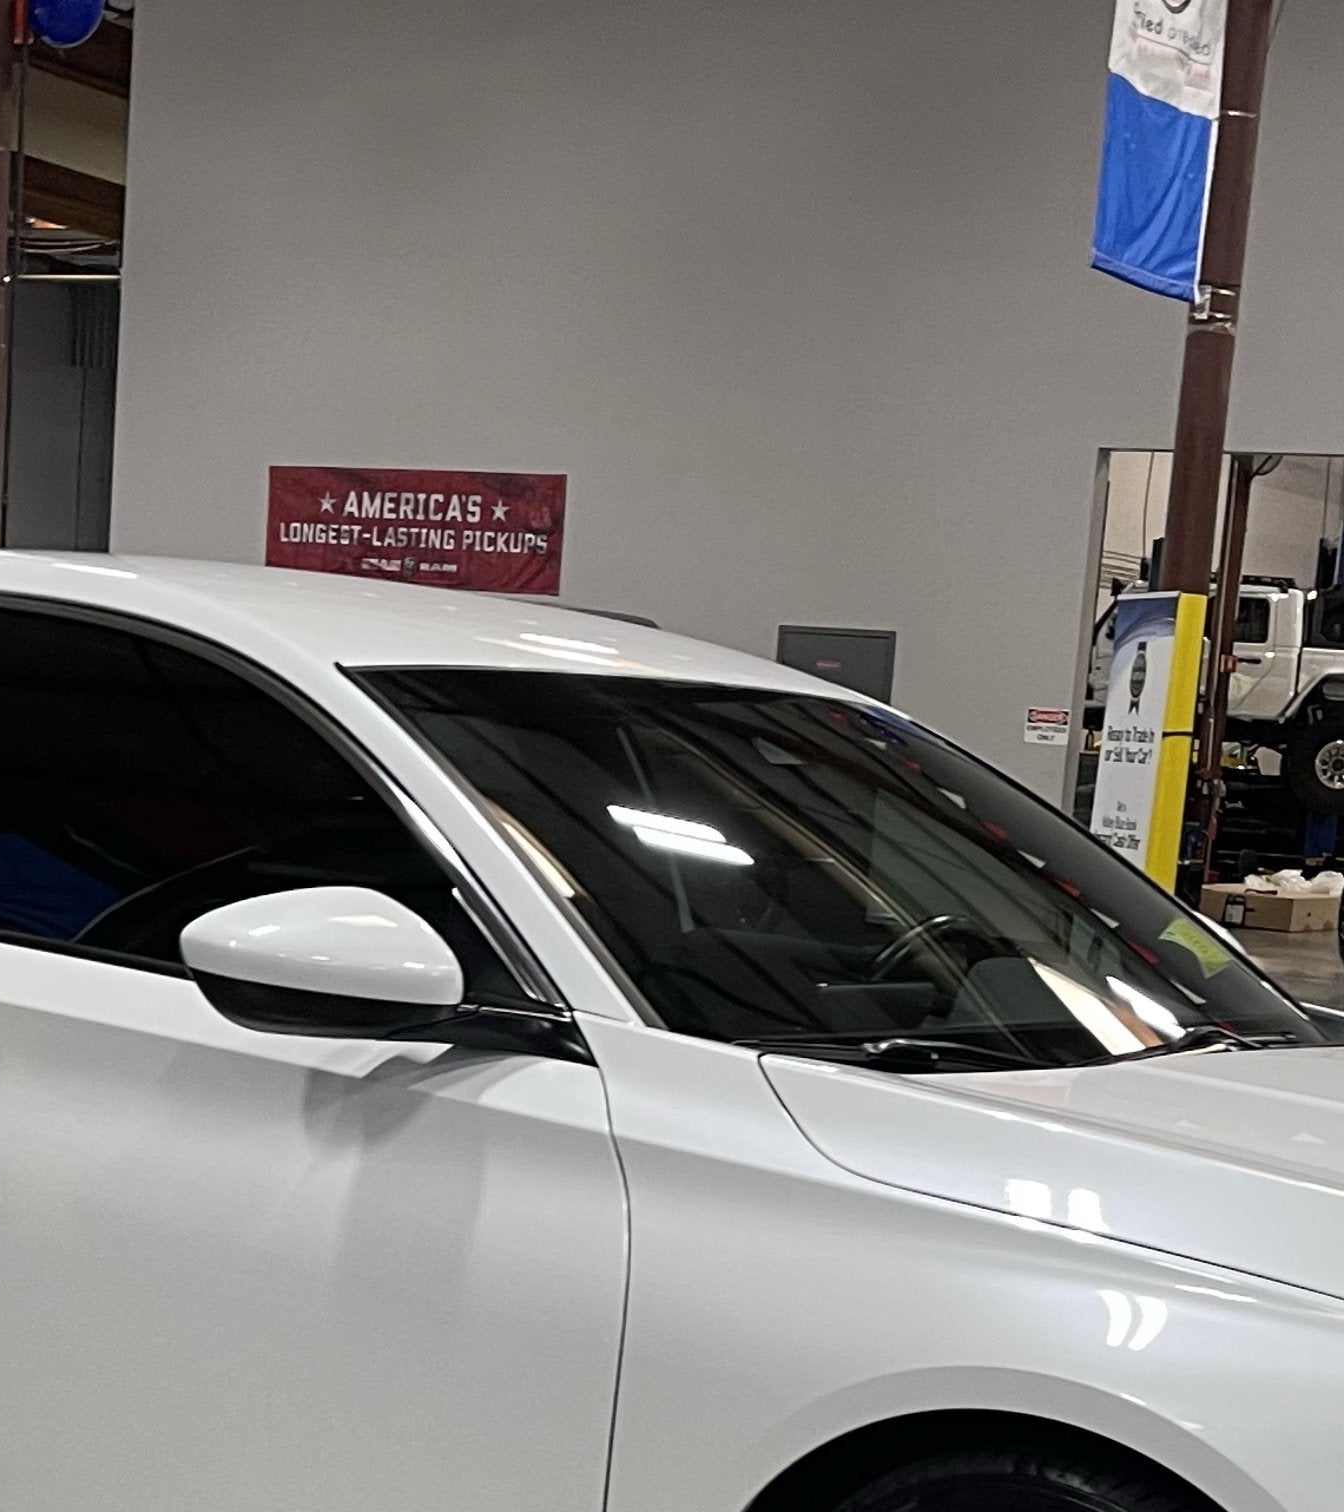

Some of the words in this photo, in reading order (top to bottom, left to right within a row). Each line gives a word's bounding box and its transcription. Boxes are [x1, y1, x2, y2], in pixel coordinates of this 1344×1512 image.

[342, 490, 482, 523] AMERICA'S
[279, 521, 455, 551] LONGEST-LASTING
[461, 529, 548, 555] PICKUPS
